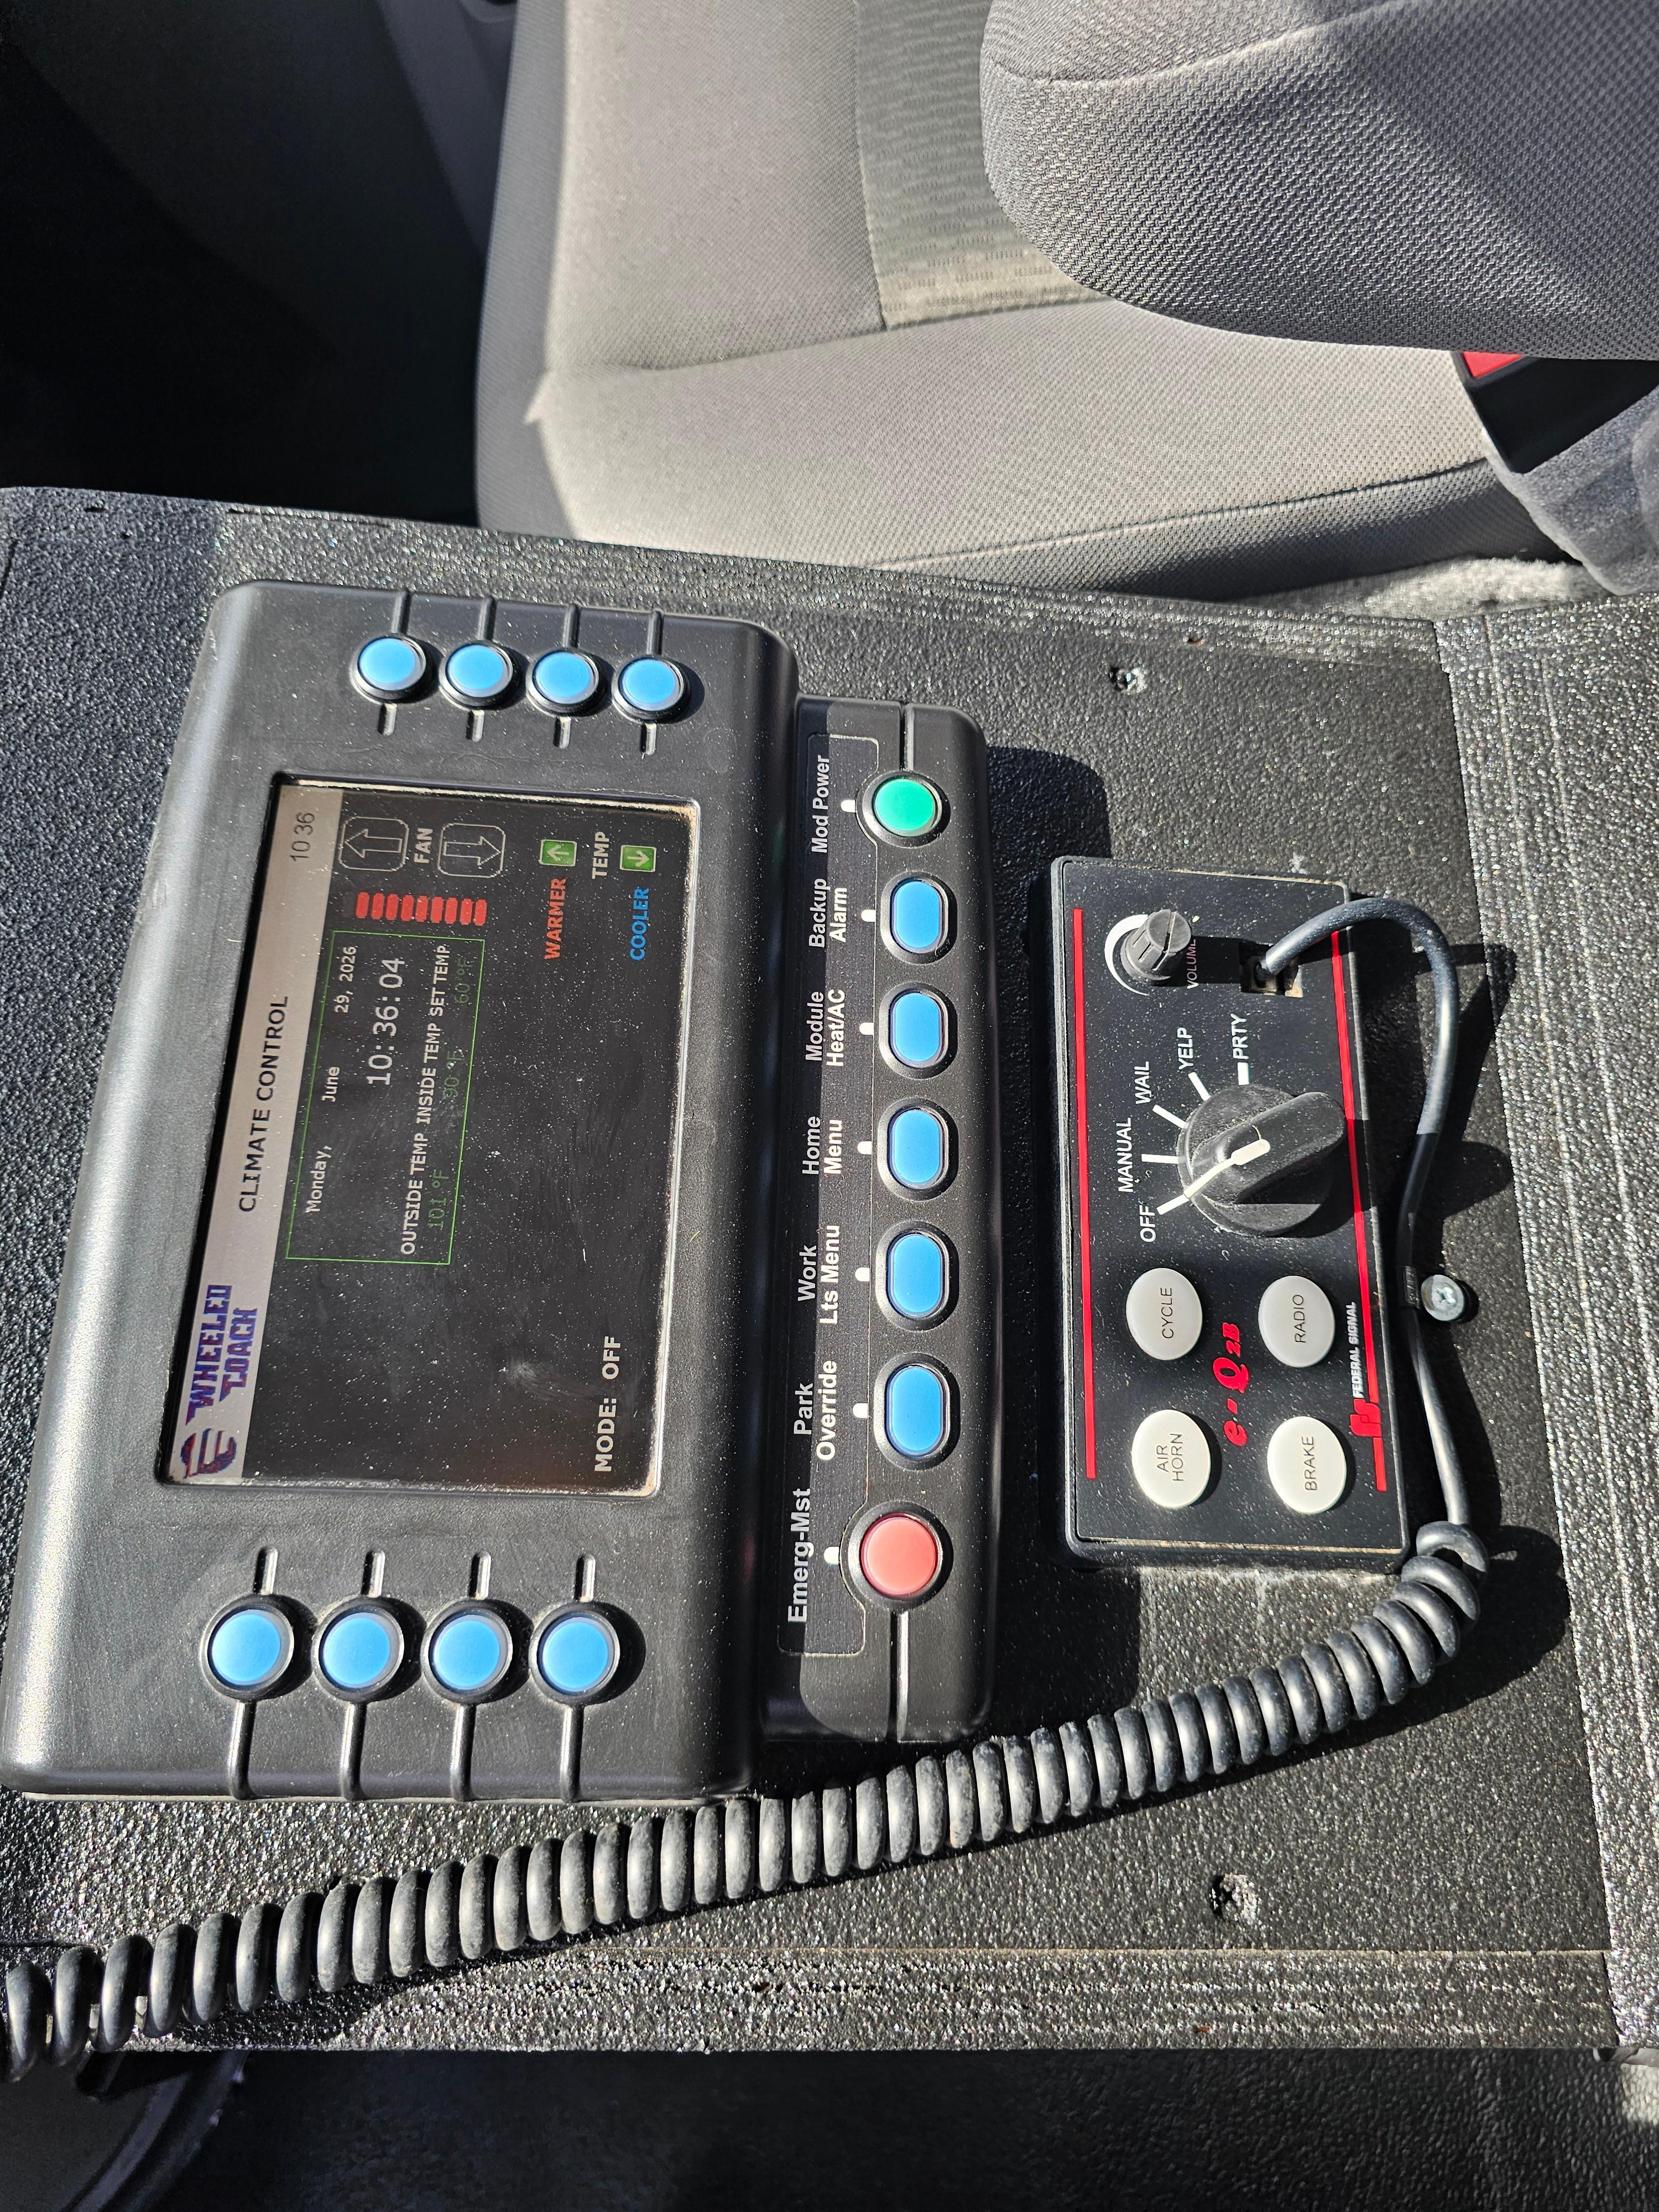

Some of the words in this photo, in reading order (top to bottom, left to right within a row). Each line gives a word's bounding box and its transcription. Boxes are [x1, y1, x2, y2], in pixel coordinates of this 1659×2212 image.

[812, 755, 830, 810] Power
[414, 828, 433, 863] FAN
[592, 831, 610, 879] TEMP
[811, 815, 829, 853] Mod
[544, 878, 566, 960] WARMER
[630, 888, 650, 961] COOLER
[808, 878, 830, 947] Backup
[829, 888, 848, 942] Alarm
[338, 946, 357, 982] 2026
[433, 945, 450, 984] TEMP
[335, 989, 354, 1013] 29,
[430, 988, 446, 1016] SET
[454, 984, 469, 1004] 60
[253, 996, 288, 1101] CONTROL
[424, 1022, 442, 1063] TEMP
[805, 992, 825, 1061] Module
[826, 989, 846, 1067] Heat/AC
[1177, 1027, 1193, 1070] YELP
[1231, 1014, 1248, 1060] PRTY
[321, 1066, 341, 1103] June
[416, 1067, 437, 1124] INSIDE
[1134, 1061, 1152, 1104] WAIL
[238, 1109, 271, 1212] CLIMATE
[410, 1132, 429, 1175] TEMP
[802, 1116, 822, 1175] Home
[824, 1119, 843, 1174] Menu
[1116, 1118, 1134, 1192] MANUAL
[305, 1145, 333, 1213] Monday,
[400, 1180, 424, 1255] OUTSIDE
[428, 1197, 447, 1229] 101
[1139, 1204, 1156, 1243] OFF
[797, 1245, 817, 1301] Work
[821, 1225, 840, 1283] Menu
[819, 1290, 839, 1324] Lts
[1160, 1287, 1174, 1339] CYCLE
[1292, 1294, 1306, 1343] RADIO
[1346, 1302, 1359, 1344] SIGNAL
[185, 1284, 232, 1425] WHEELED
[218, 1307, 258, 1402] COACH
[602, 1336, 620, 1380] OFF
[1349, 1347, 1364, 1398] FEDERAL
[794, 1383, 814, 1434] Park
[815, 1360, 838, 1460] Override
[595, 1397, 617, 1472] MODE:
[1156, 1445, 1169, 1473] AIR
[1168, 1433, 1184, 1482] HORN
[1301, 1436, 1318, 1491] BRAKE
[788, 1488, 813, 1623] Emerg-Mst
